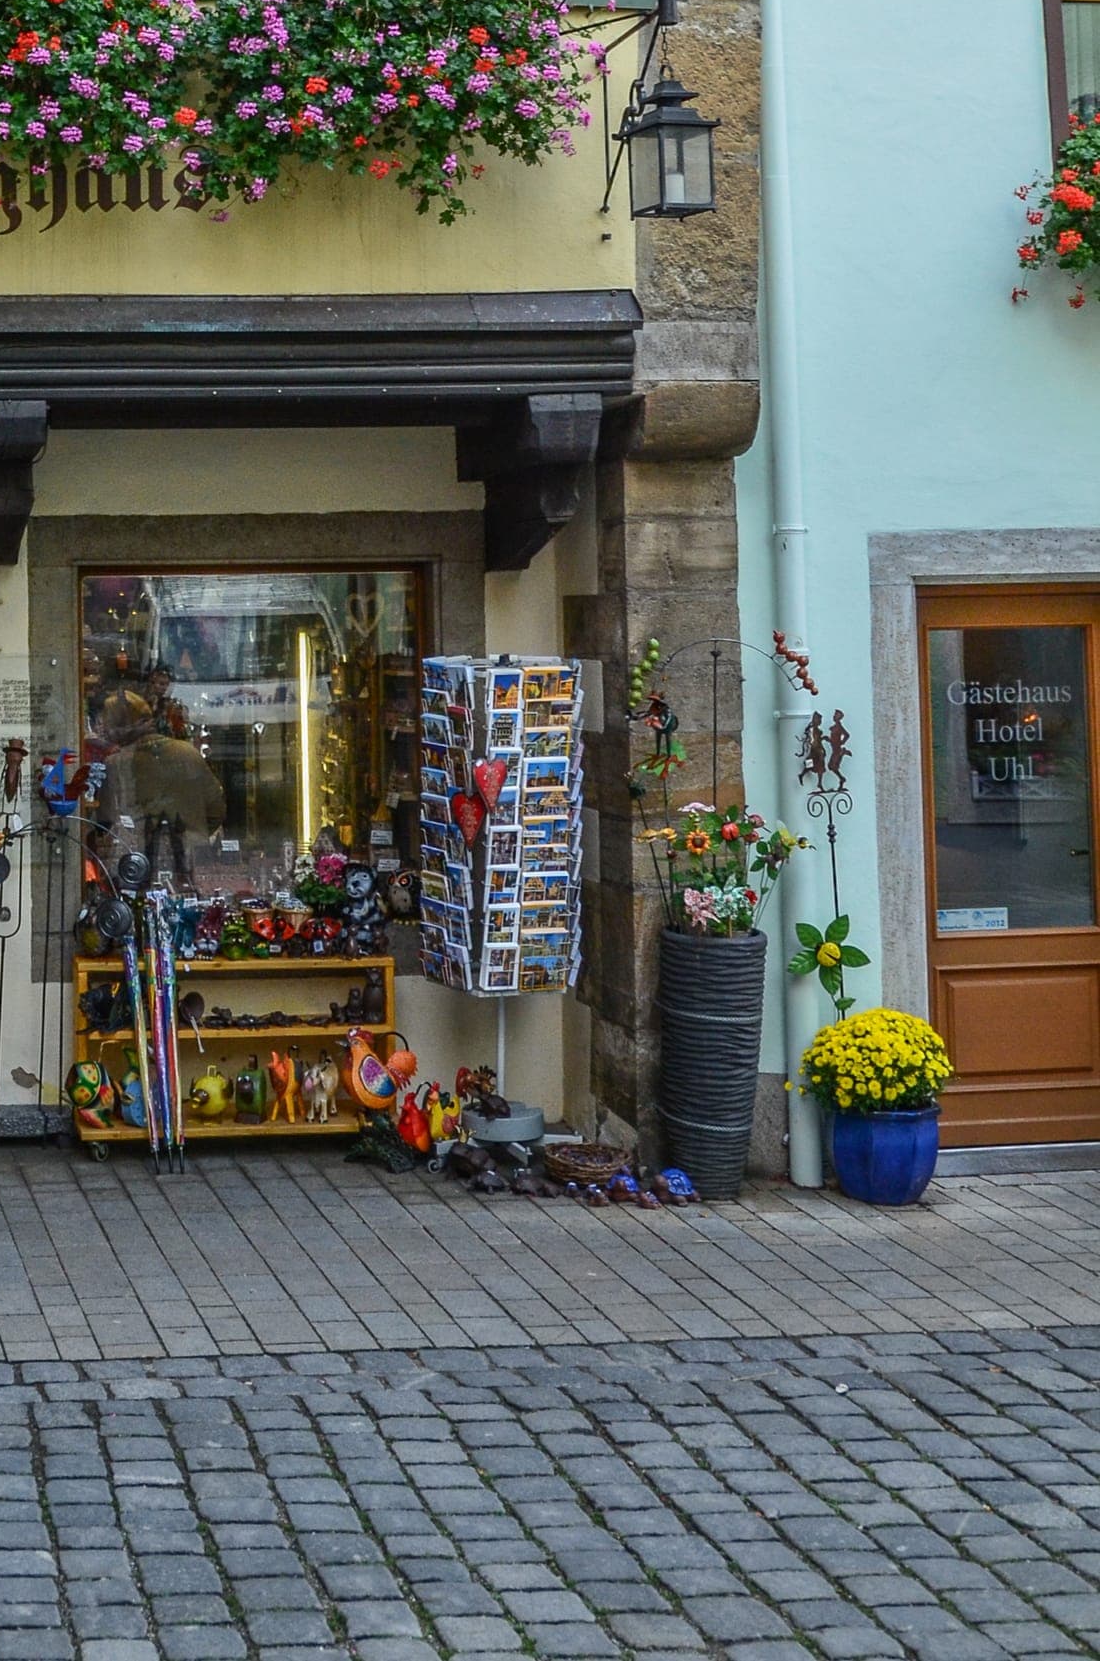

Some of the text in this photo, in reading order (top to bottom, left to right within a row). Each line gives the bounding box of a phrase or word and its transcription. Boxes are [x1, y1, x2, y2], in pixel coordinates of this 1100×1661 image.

[946, 679, 1072, 706] Gästehaus
[975, 716, 1044, 744] Hotel
[988, 755, 1035, 782] Uhl
